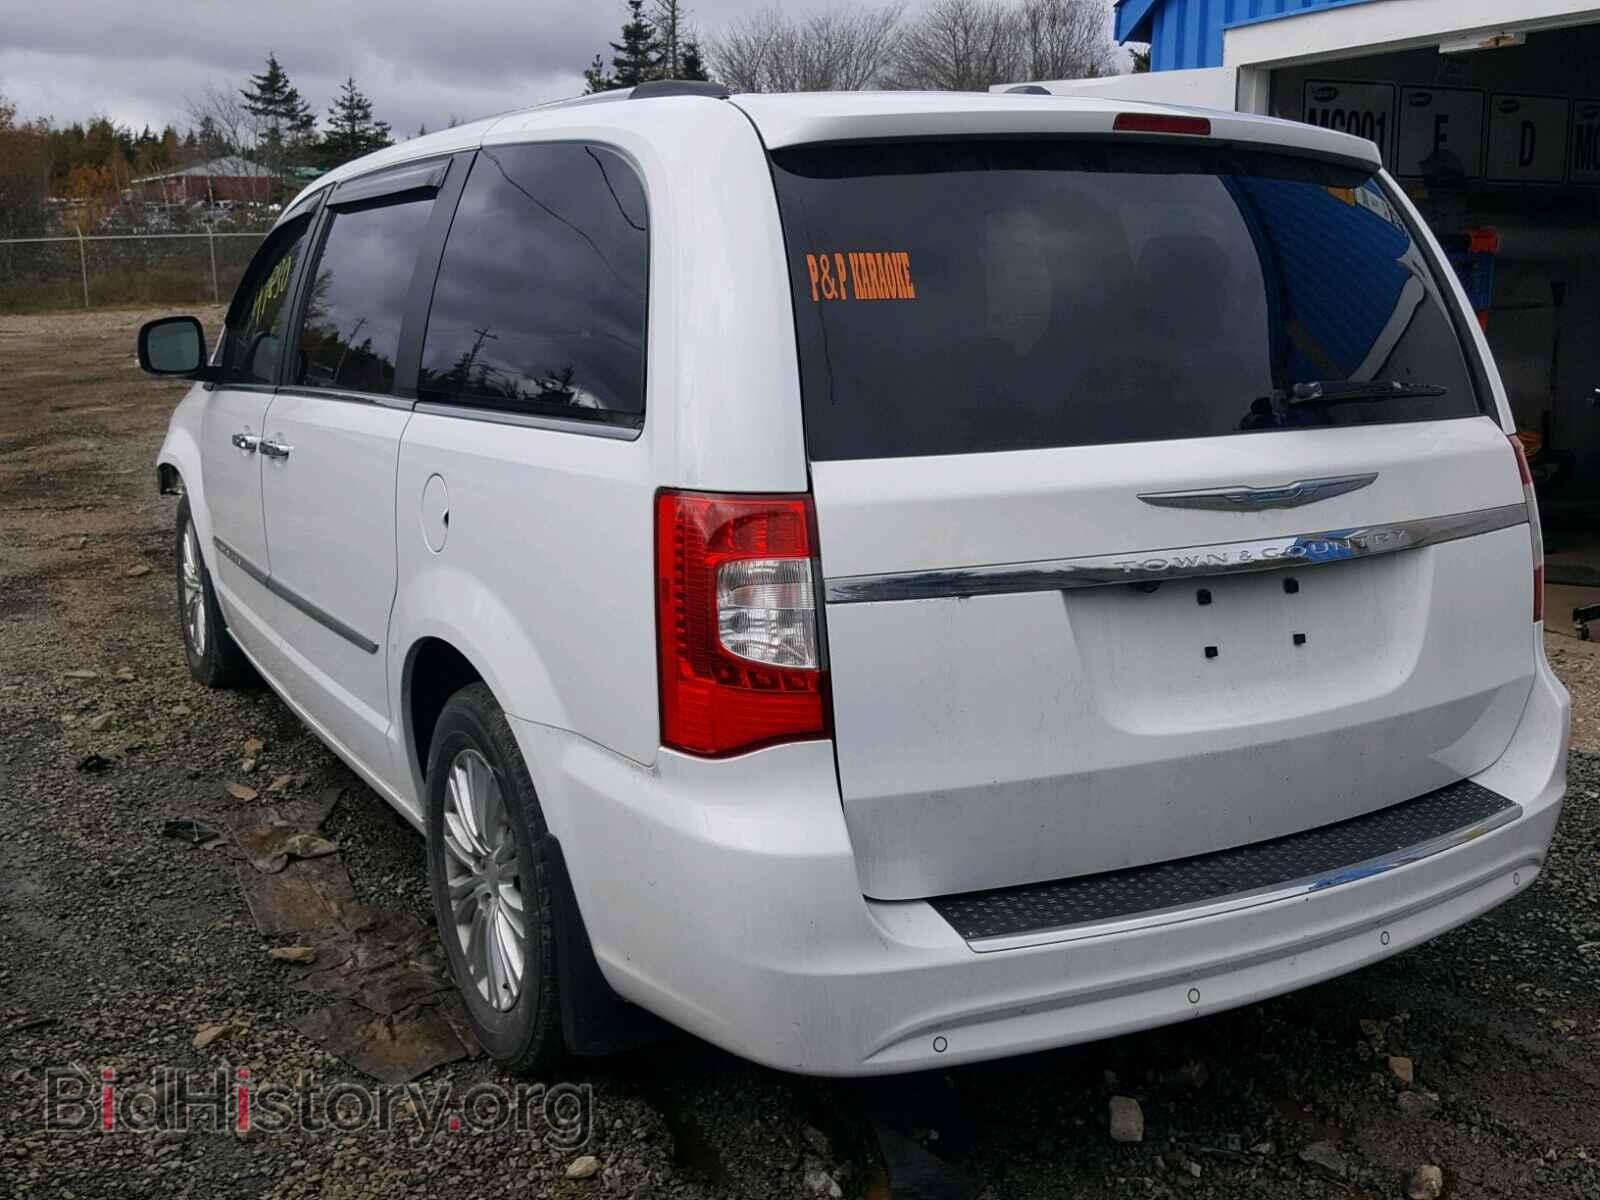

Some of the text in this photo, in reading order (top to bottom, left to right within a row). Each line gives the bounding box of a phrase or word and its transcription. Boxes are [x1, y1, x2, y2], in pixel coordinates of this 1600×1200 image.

[1519, 120, 1536, 167] D
[806, 250, 916, 301] P&P KARAOKE
[1113, 529, 1408, 573] TOWN & COUNTRY
